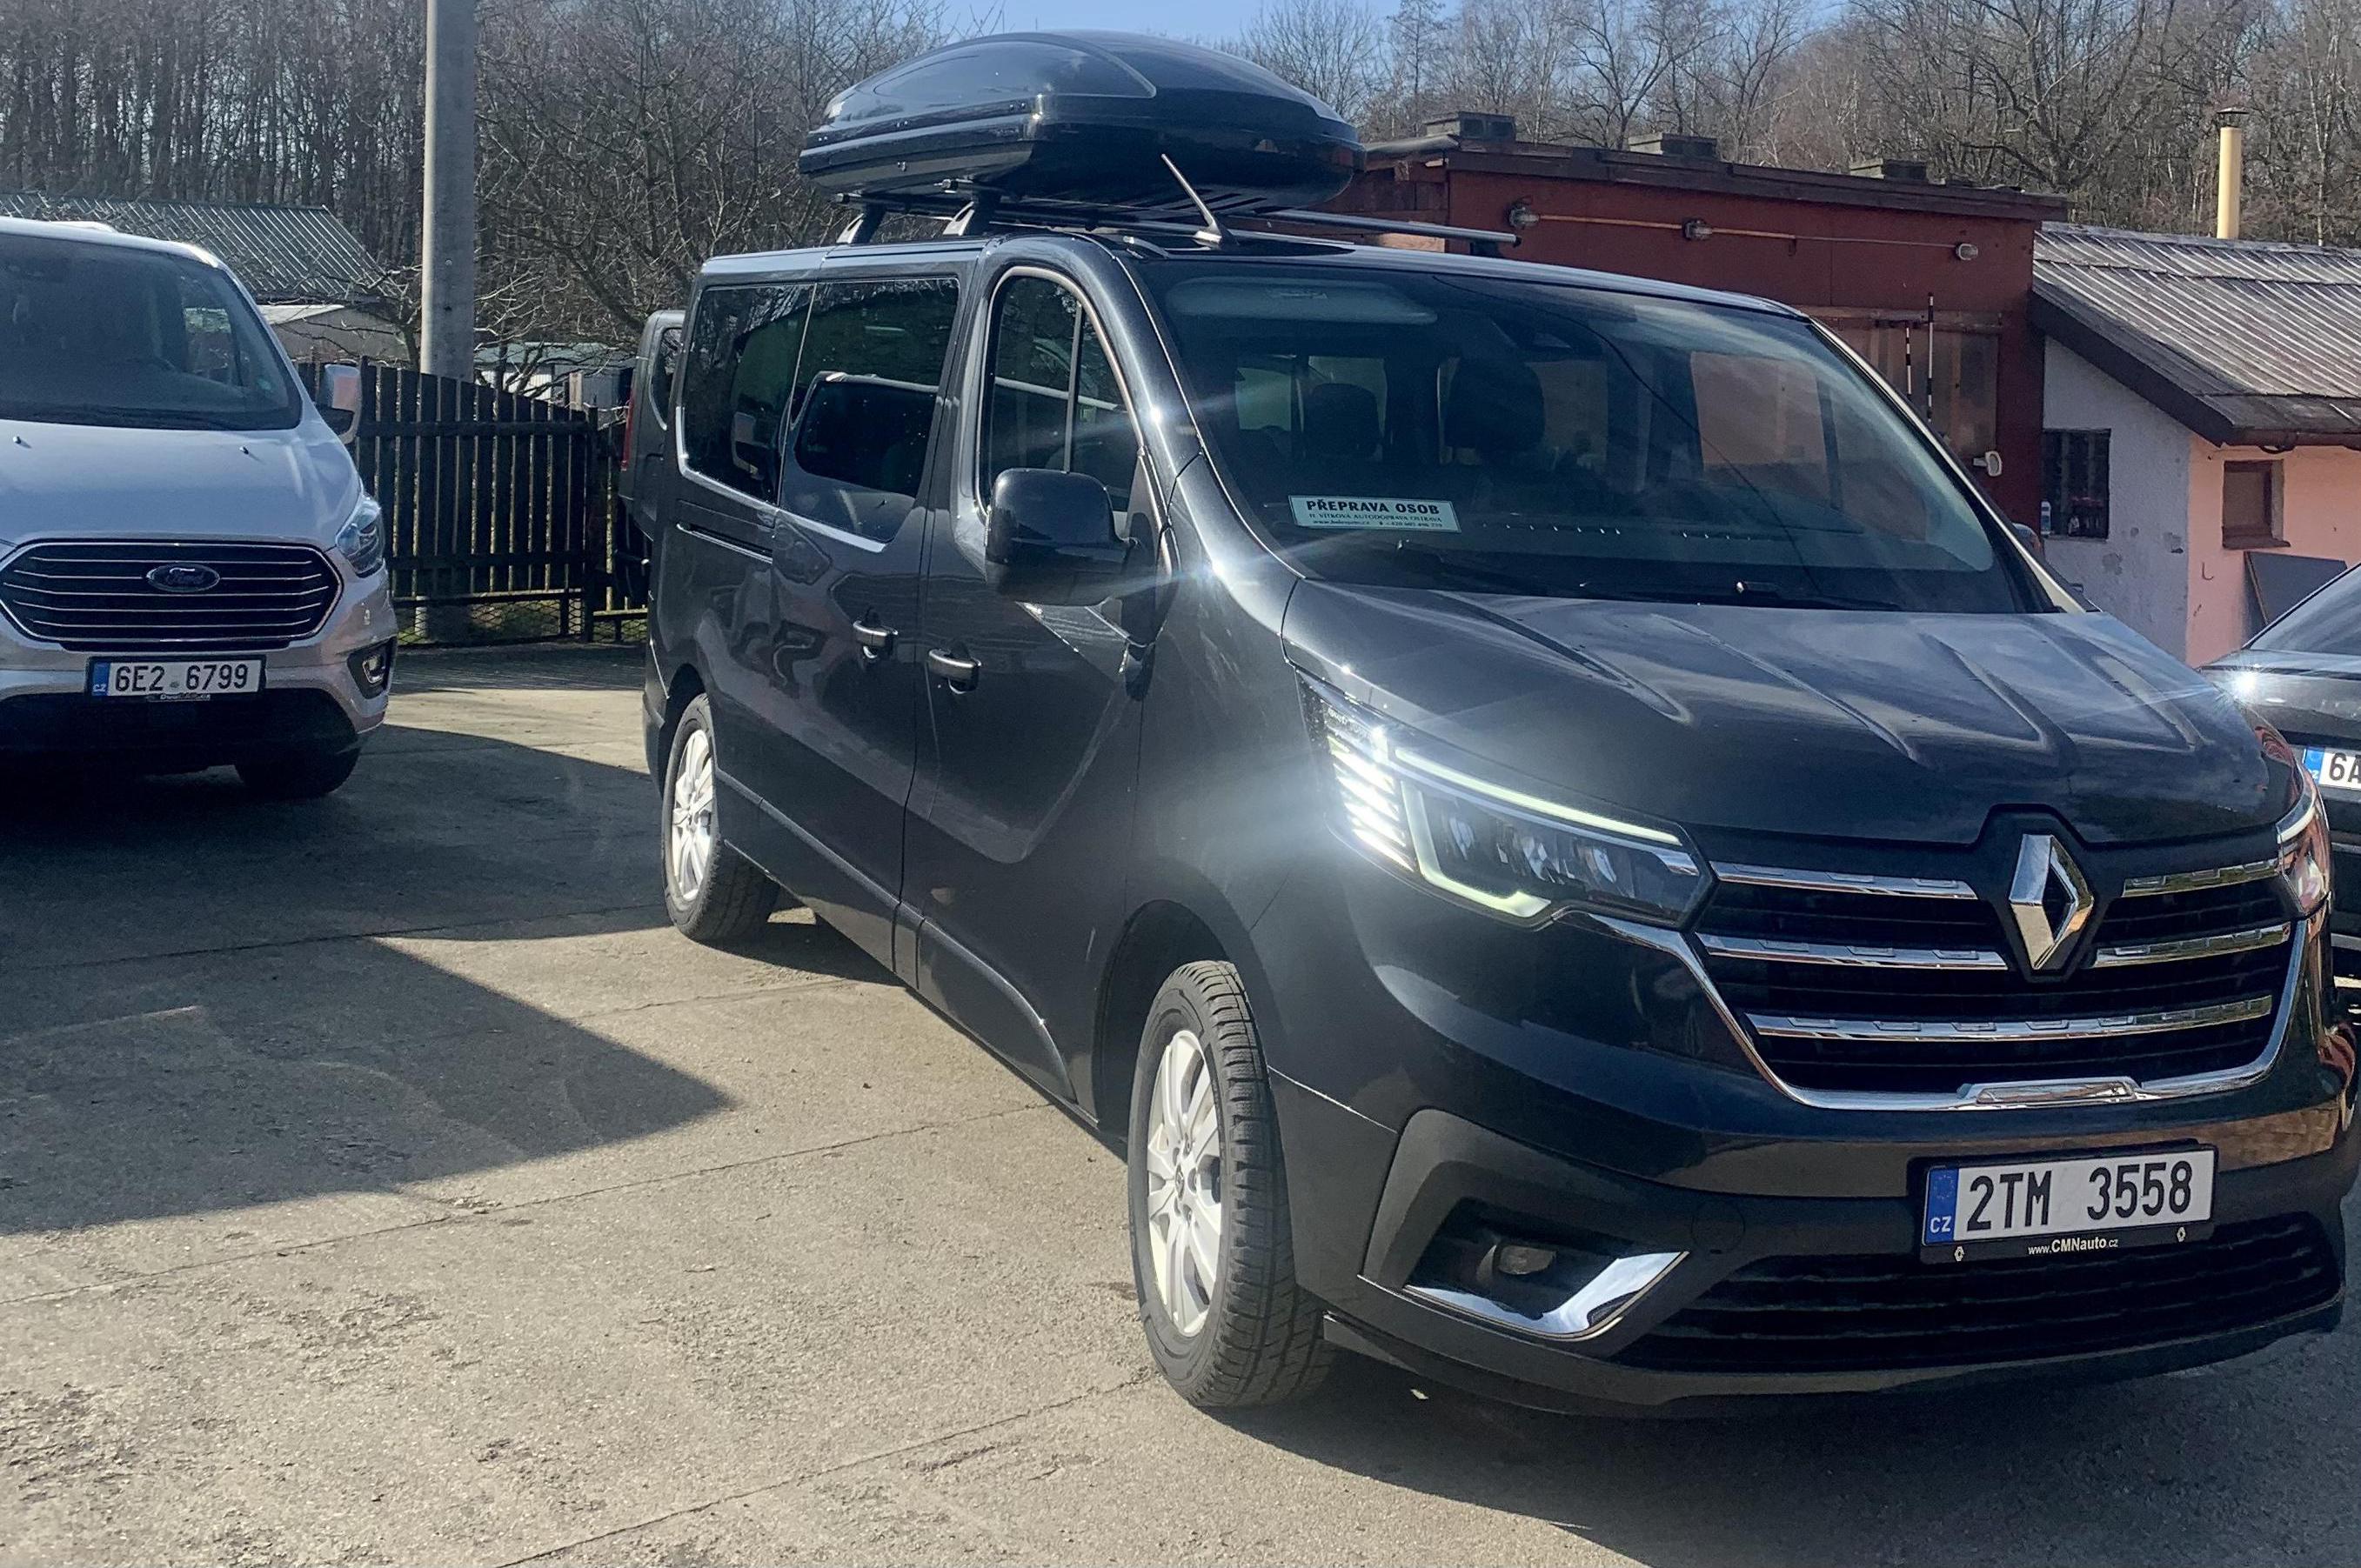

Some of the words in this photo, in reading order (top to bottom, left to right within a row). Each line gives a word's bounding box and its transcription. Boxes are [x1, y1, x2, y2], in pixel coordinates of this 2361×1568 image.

[1306, 498, 1389, 513] PŘEPRAVA
[1395, 503, 1440, 515] OSOB
[115, 665, 165, 692] 6E2
[186, 664, 249, 690] 6799
[1930, 1216, 1951, 1234] CZ
[1966, 1170, 2052, 1232] 2TM
[2087, 1160, 2193, 1221] 3558
[2028, 1236, 2119, 1256] www.CMNauto.cz
